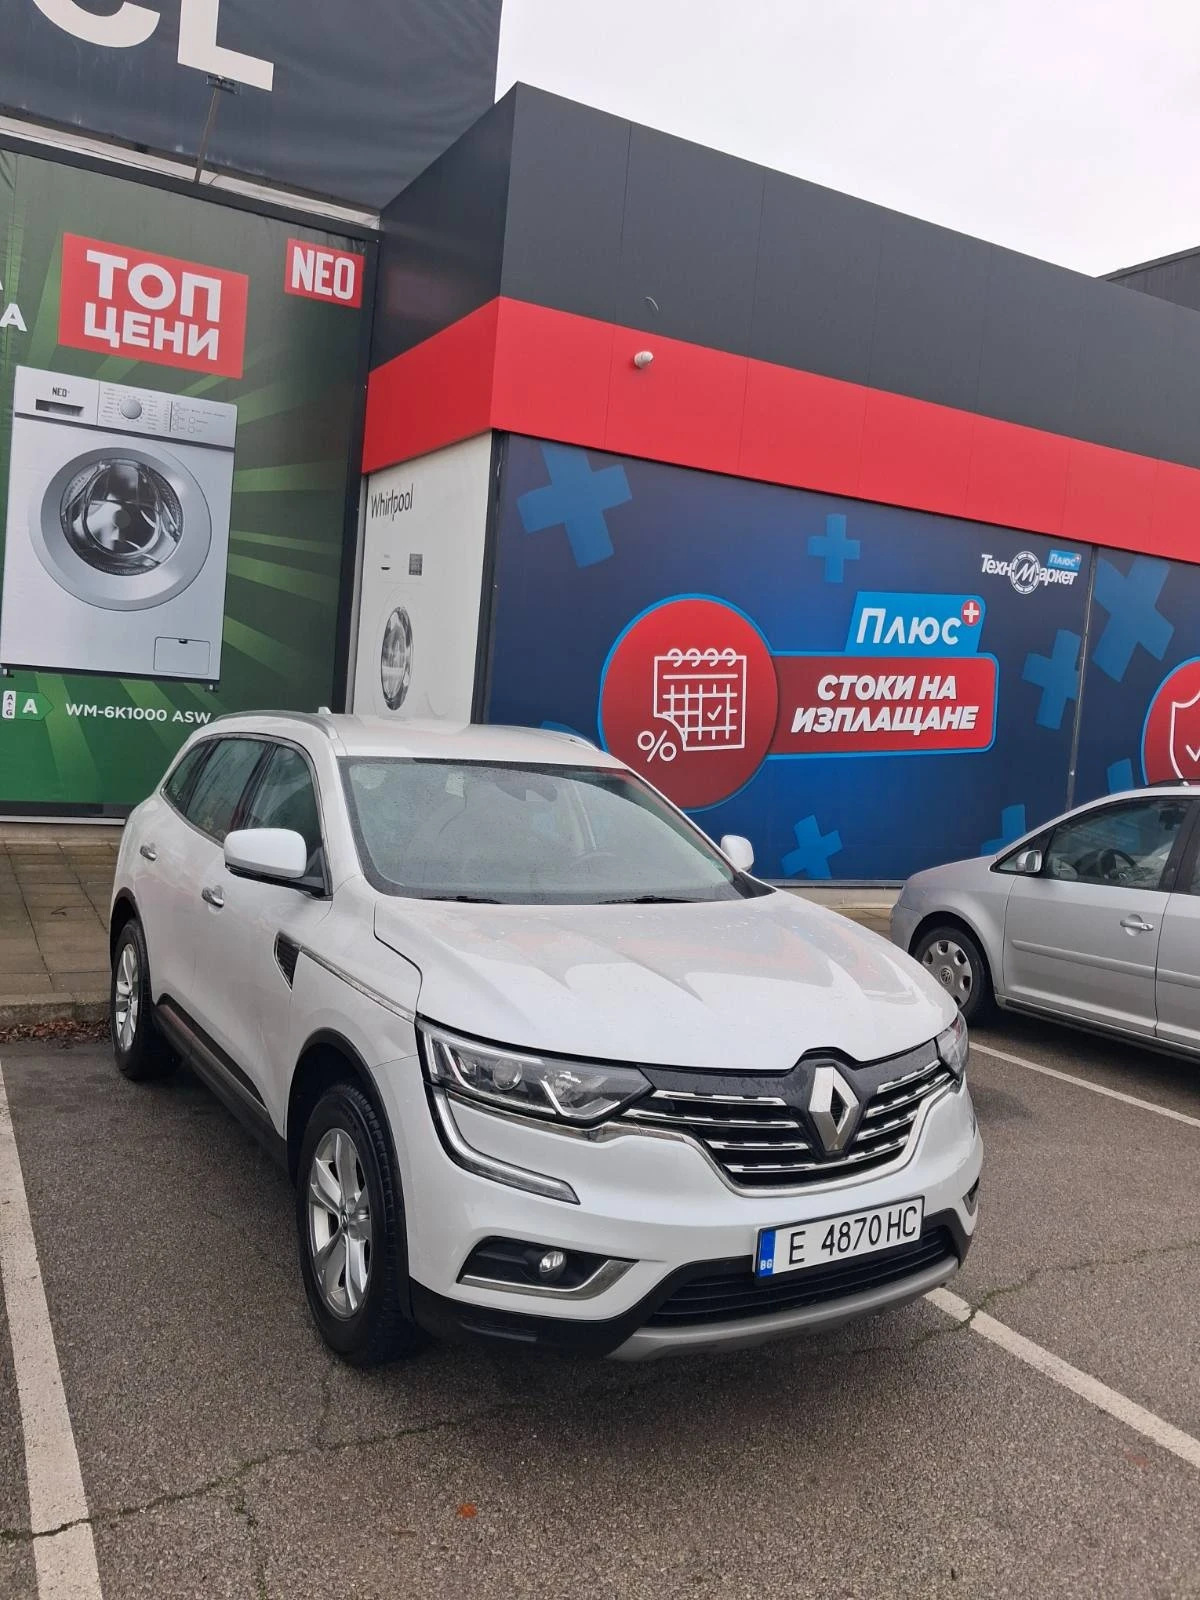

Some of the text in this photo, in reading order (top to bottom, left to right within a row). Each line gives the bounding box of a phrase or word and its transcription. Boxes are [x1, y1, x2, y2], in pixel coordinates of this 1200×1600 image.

[86, 249, 222, 323] ТОП
[291, 246, 355, 300] NEO
[84, 302, 219, 361] ЦЕНИ
[52, 386, 67, 397] NEO
[371, 483, 414, 521] Whirlpool
[817, 675, 957, 701] СТОКИ НА
[22, 698, 38, 714] A
[66, 703, 211, 724] WM-6K1000 ASW
[791, 706, 980, 735] ИЗПЛАЩАНЕ
[789, 1231, 806, 1265] E
[760, 1259, 773, 1271] BG
